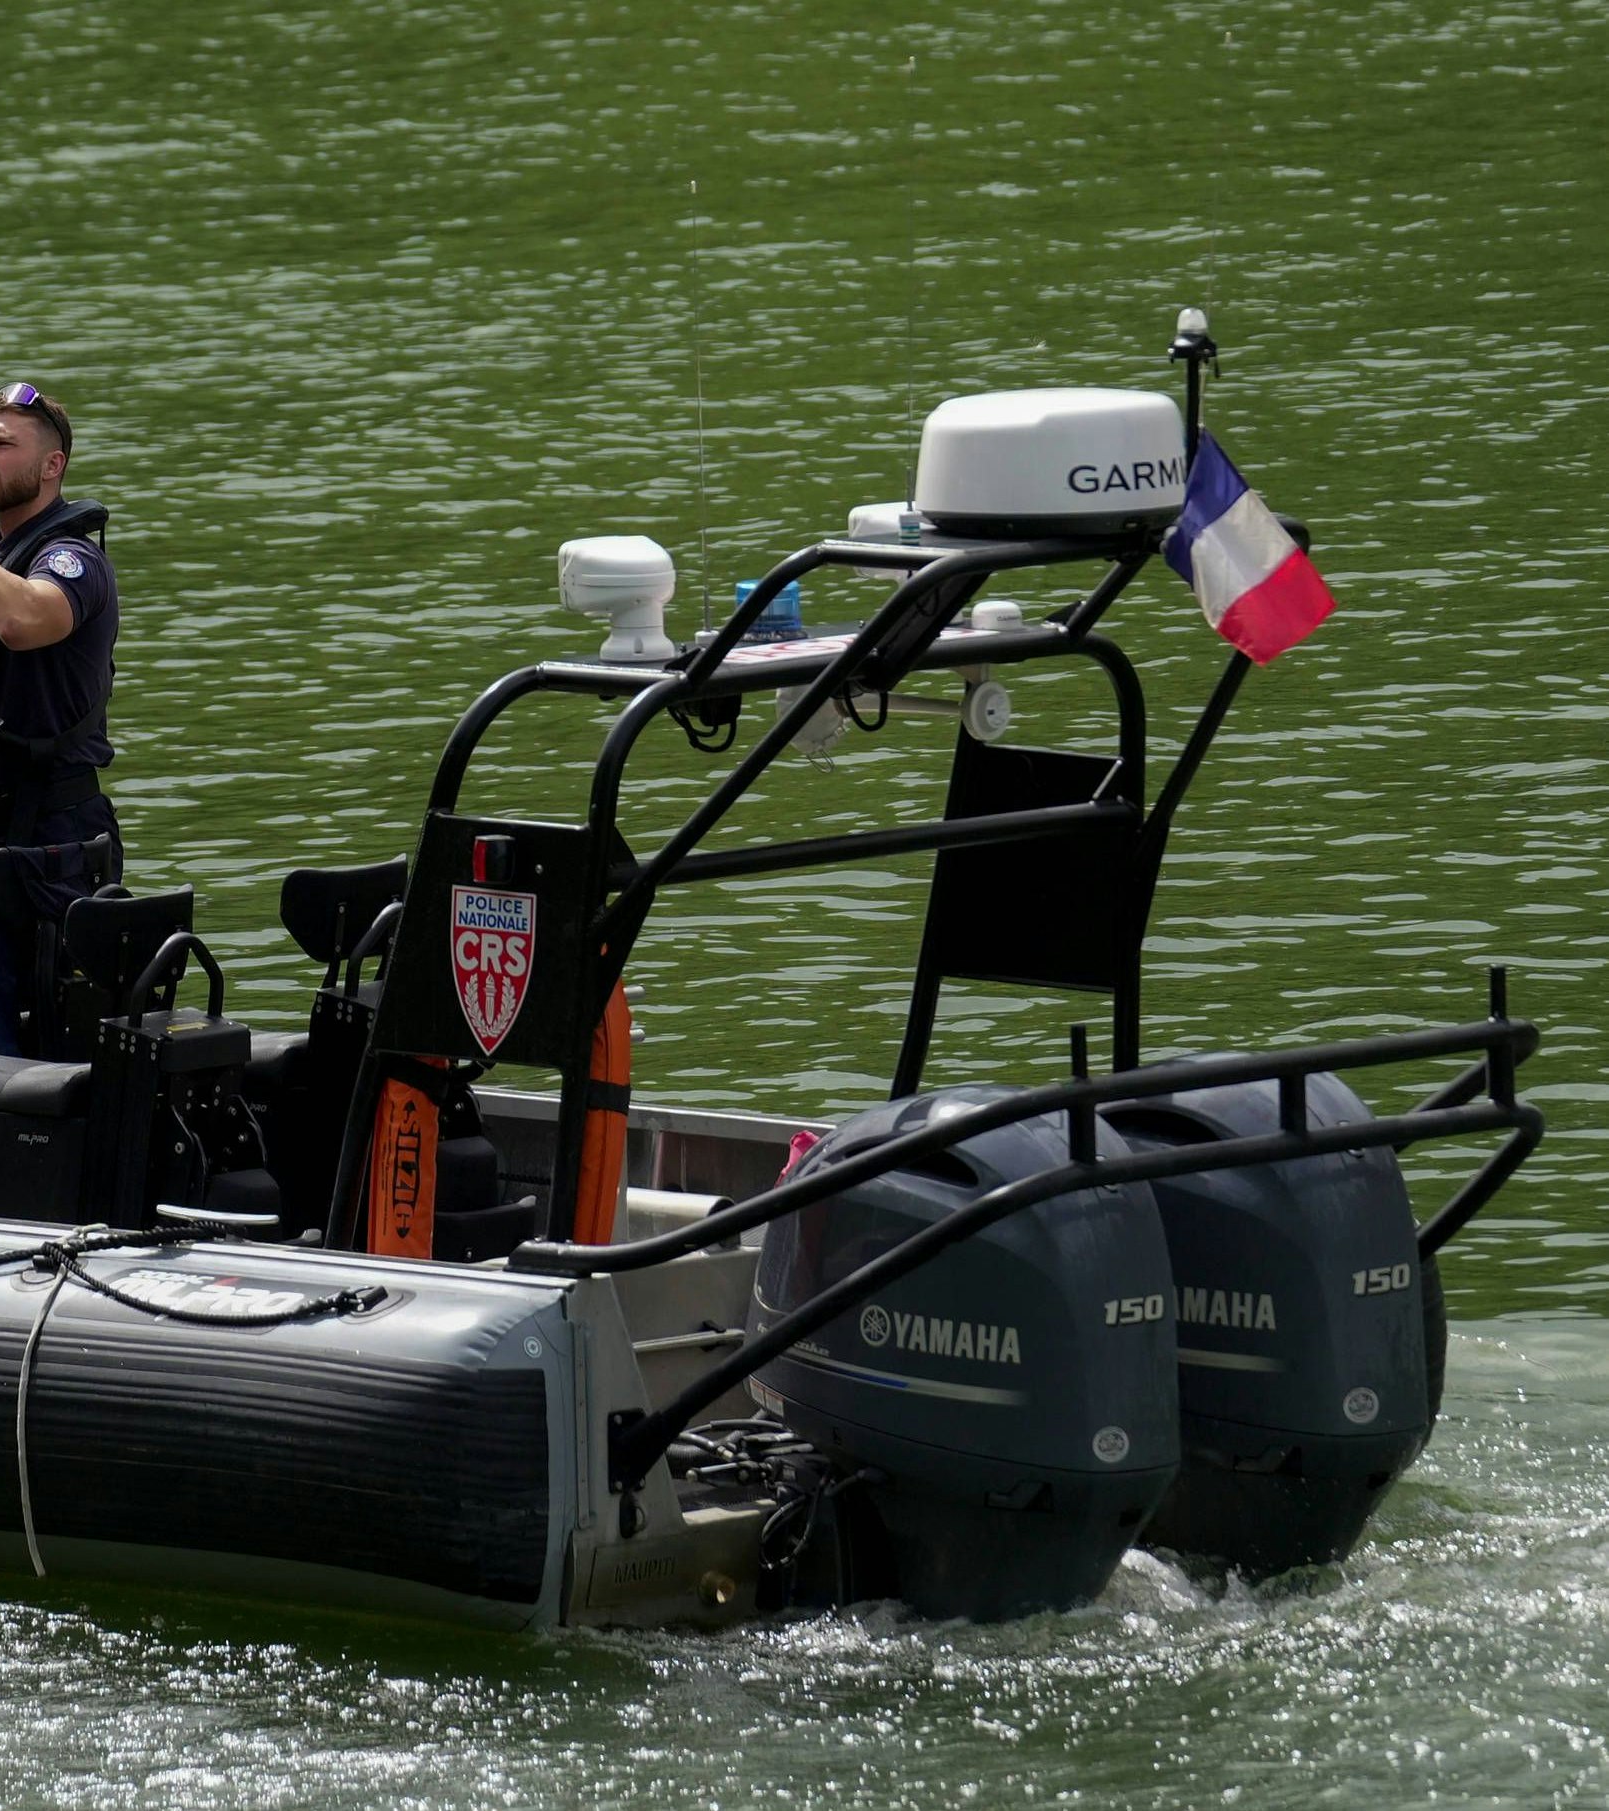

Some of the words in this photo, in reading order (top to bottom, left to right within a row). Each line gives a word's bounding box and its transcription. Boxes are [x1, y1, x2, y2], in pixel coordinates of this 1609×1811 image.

[1067, 457, 1187, 493] GARMI
[458, 911, 528, 932] NATIONALE
[465, 895, 523, 914] POLICE
[455, 931, 527, 977] CRS
[1352, 1263, 1410, 1295] 150
[1103, 1294, 1164, 1325] 150
[1174, 1286, 1276, 1331] MAHA
[893, 1311, 1021, 1364] YAMAHA
